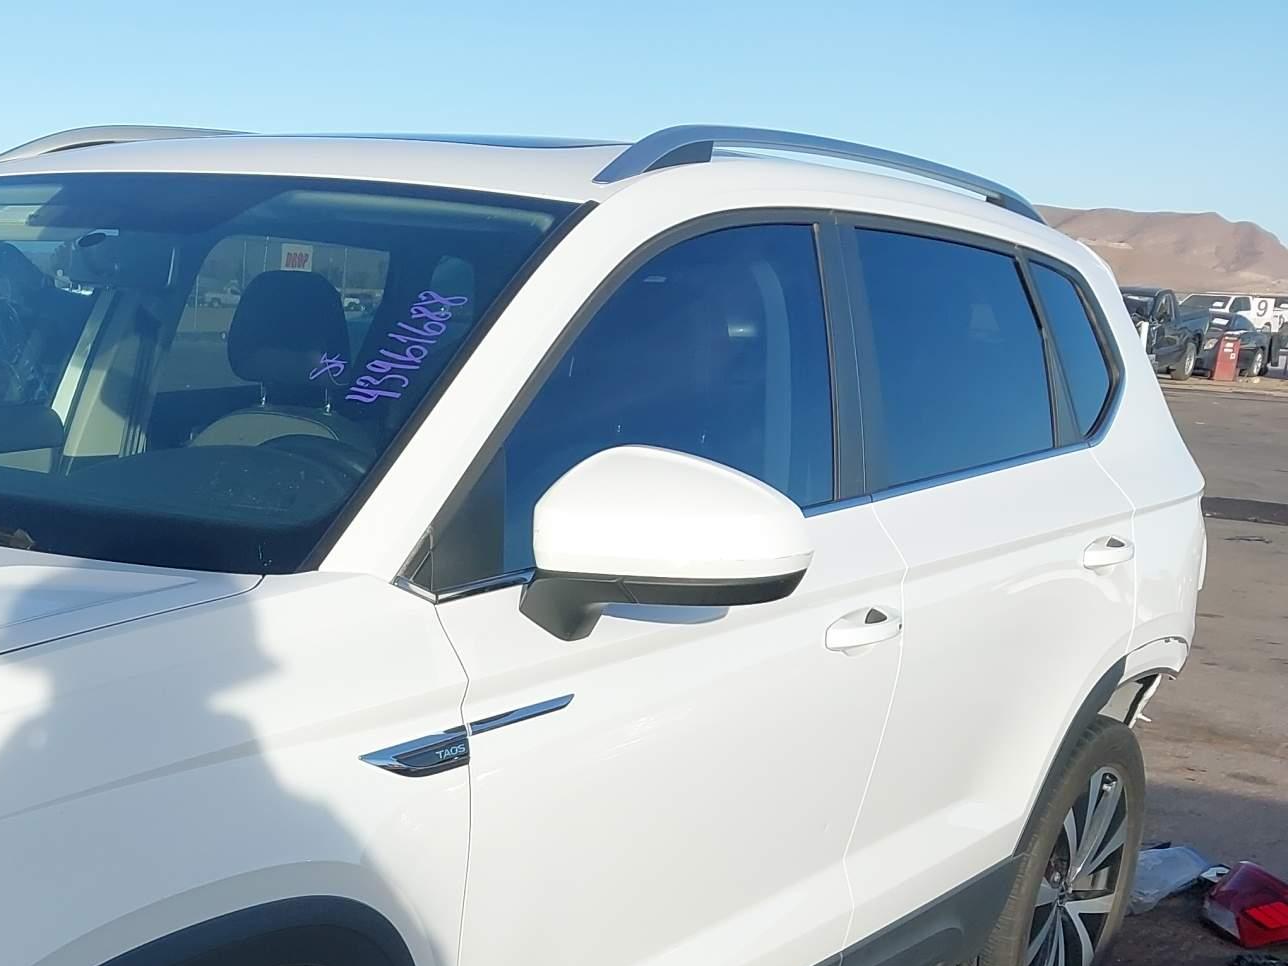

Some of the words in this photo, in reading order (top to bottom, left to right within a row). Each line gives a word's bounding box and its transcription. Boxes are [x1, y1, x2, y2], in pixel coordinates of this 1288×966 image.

[1256, 299, 1268, 317] 9
[345, 290, 468, 403] 43961688
[435, 743, 466, 759] TAOS
